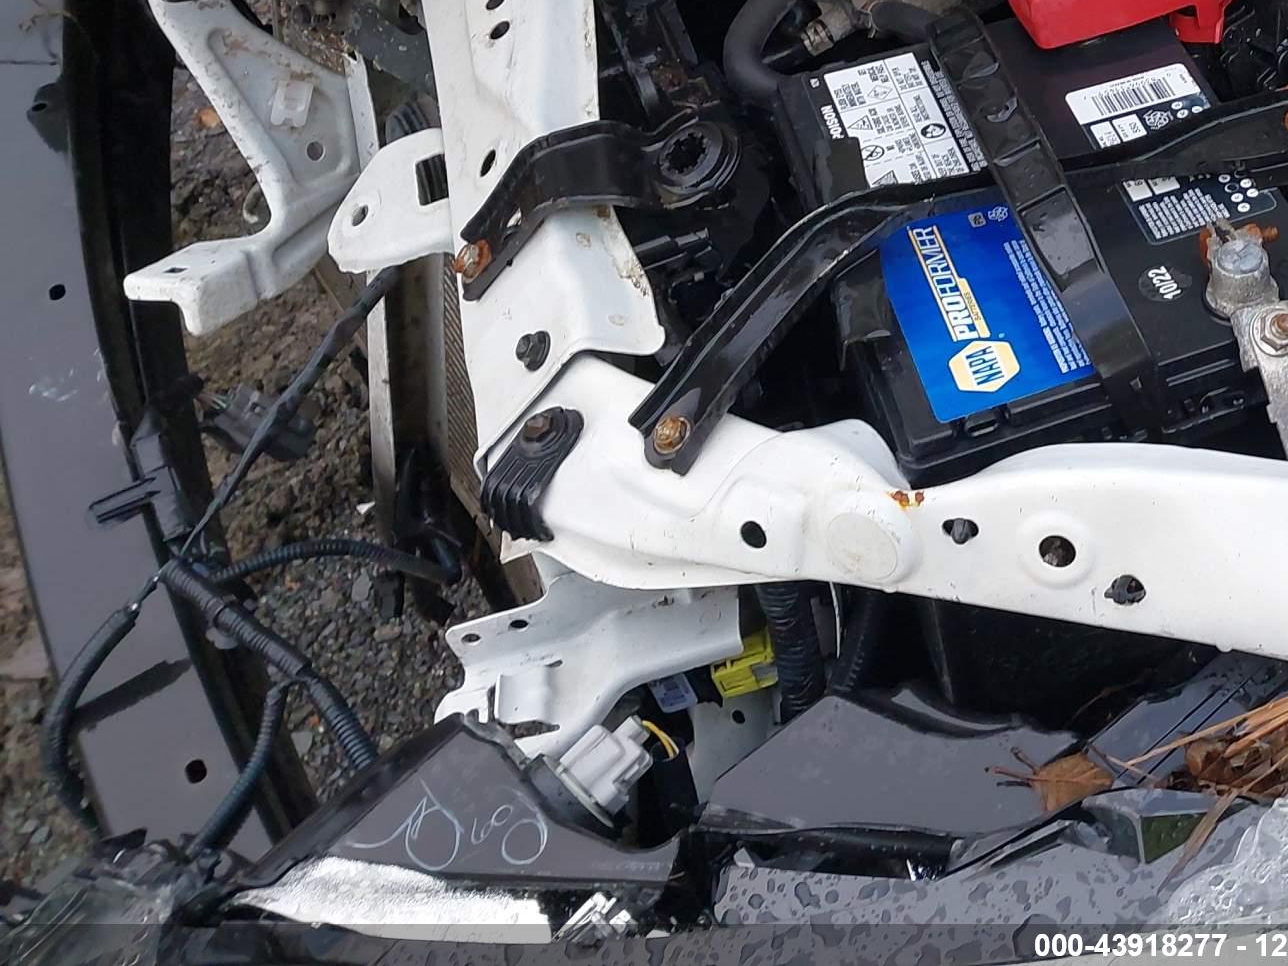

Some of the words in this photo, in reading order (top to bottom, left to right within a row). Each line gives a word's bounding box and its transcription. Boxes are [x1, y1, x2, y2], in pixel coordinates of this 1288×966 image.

[912, 226, 978, 341] PROFORMER
[1148, 266, 1182, 299] 10/22
[964, 292, 982, 321] BATTERIES
[965, 346, 1005, 385] NAPA
